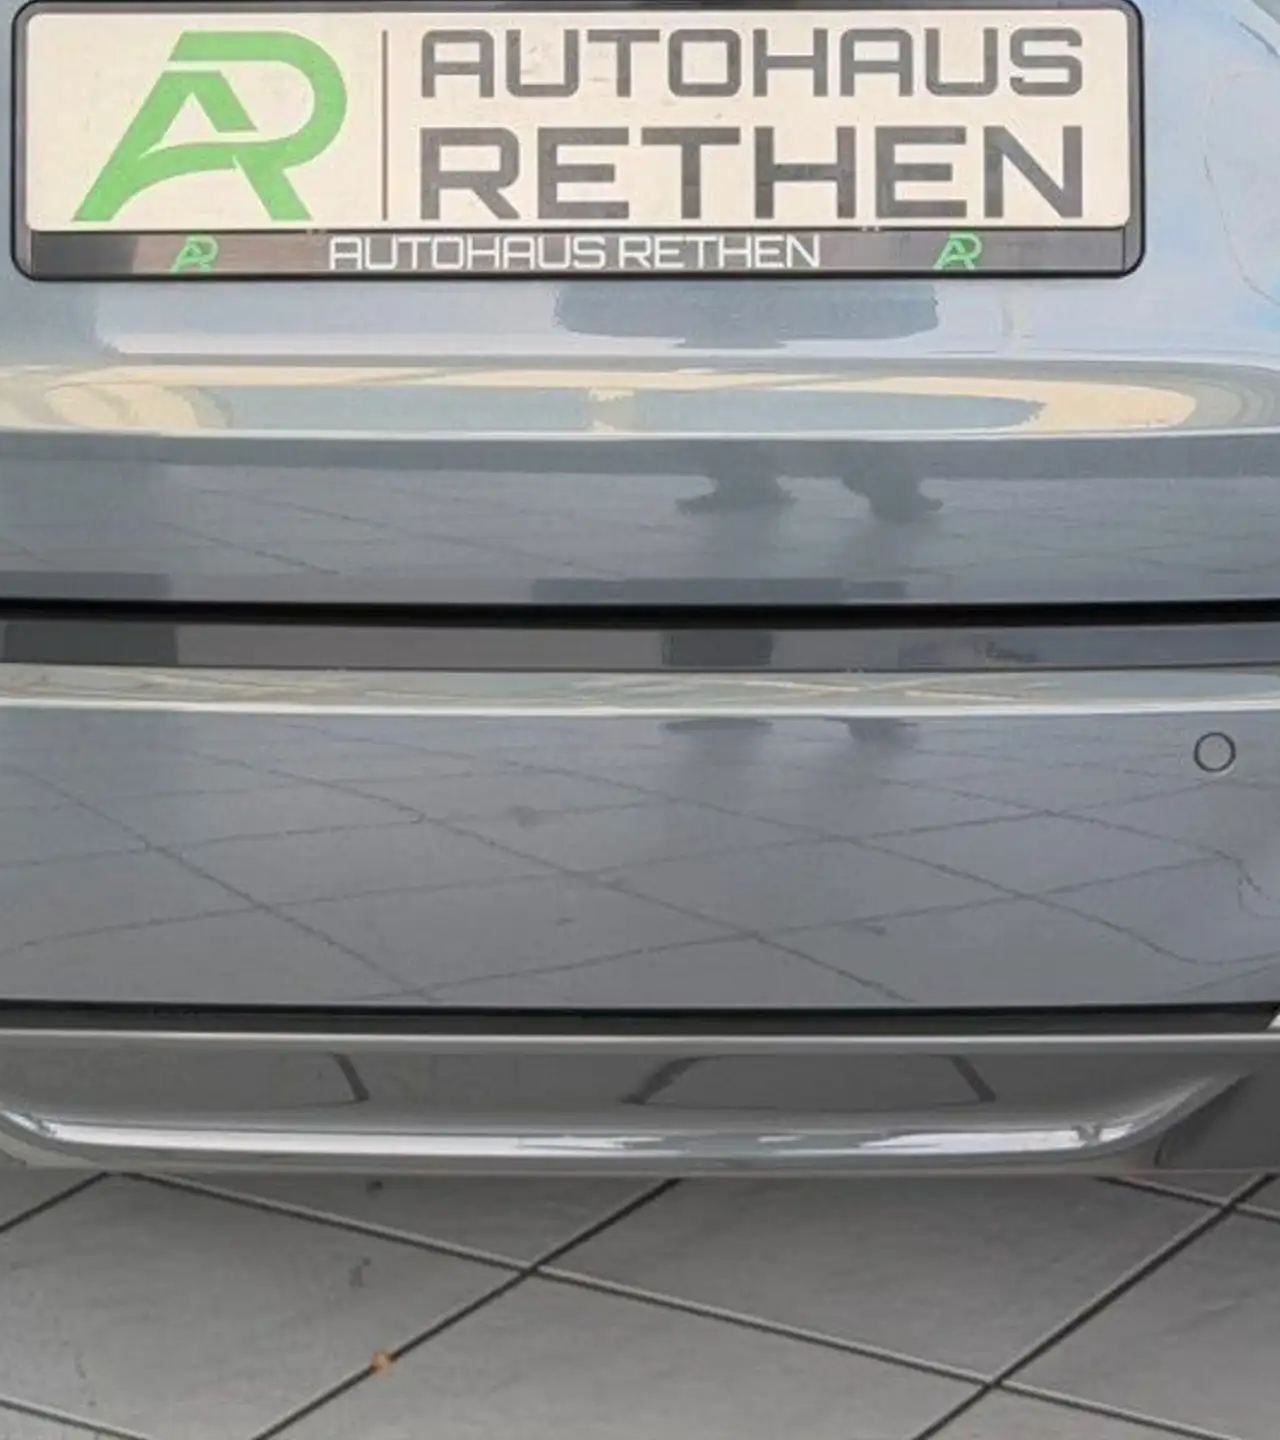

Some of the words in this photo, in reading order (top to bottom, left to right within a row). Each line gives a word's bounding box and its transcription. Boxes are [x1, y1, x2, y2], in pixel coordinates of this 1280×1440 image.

[420, 28, 1083, 98] AUTOHAUS
[420, 126, 1083, 220] RETHEN
[328, 234, 607, 270] AUTOHAUS
[618, 234, 820, 269] RETHEN
